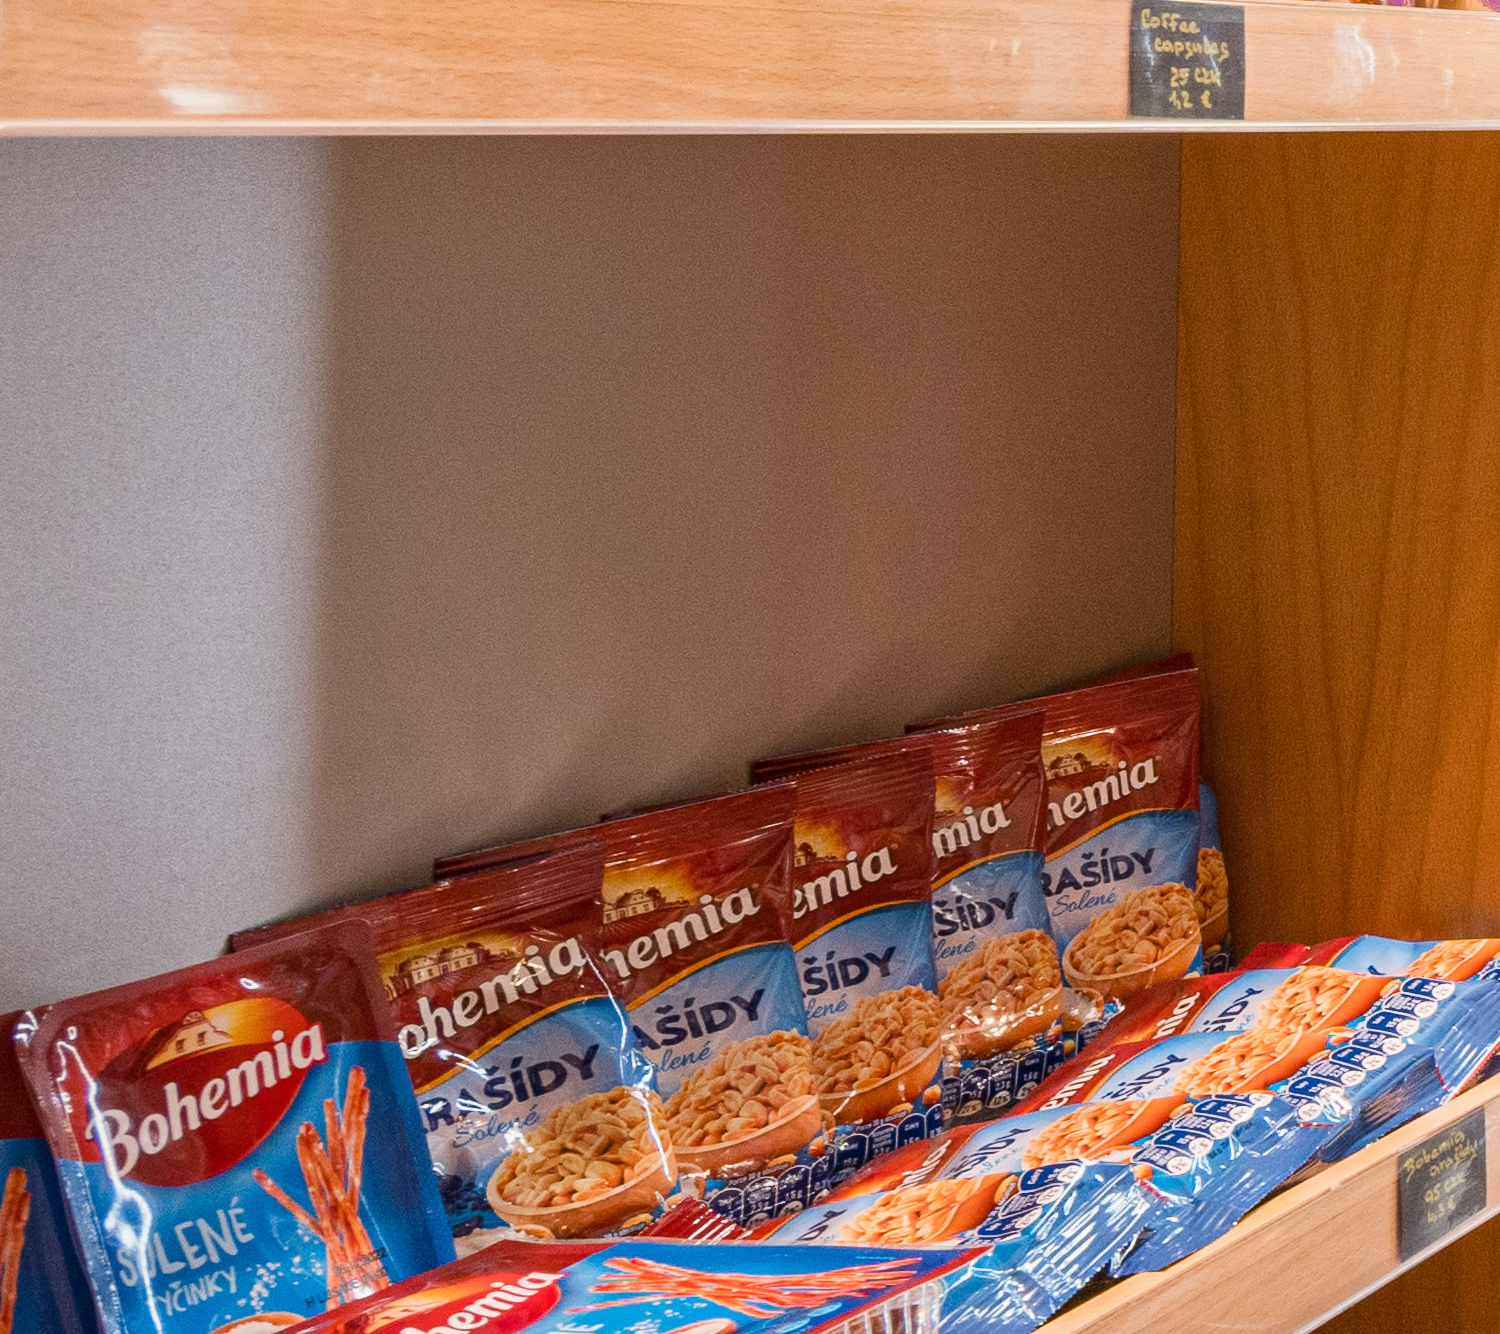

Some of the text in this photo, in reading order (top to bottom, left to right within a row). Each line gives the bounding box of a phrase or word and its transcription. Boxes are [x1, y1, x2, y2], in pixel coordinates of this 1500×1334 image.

[1141, 9, 1200, 35] Coffee
[1041, 846, 1158, 898] RAŠÍDY
[397, 935, 587, 1062] ohemia
[87, 1021, 328, 1180] Bohemia
[424, 1043, 601, 1136] RAŠÍDY
